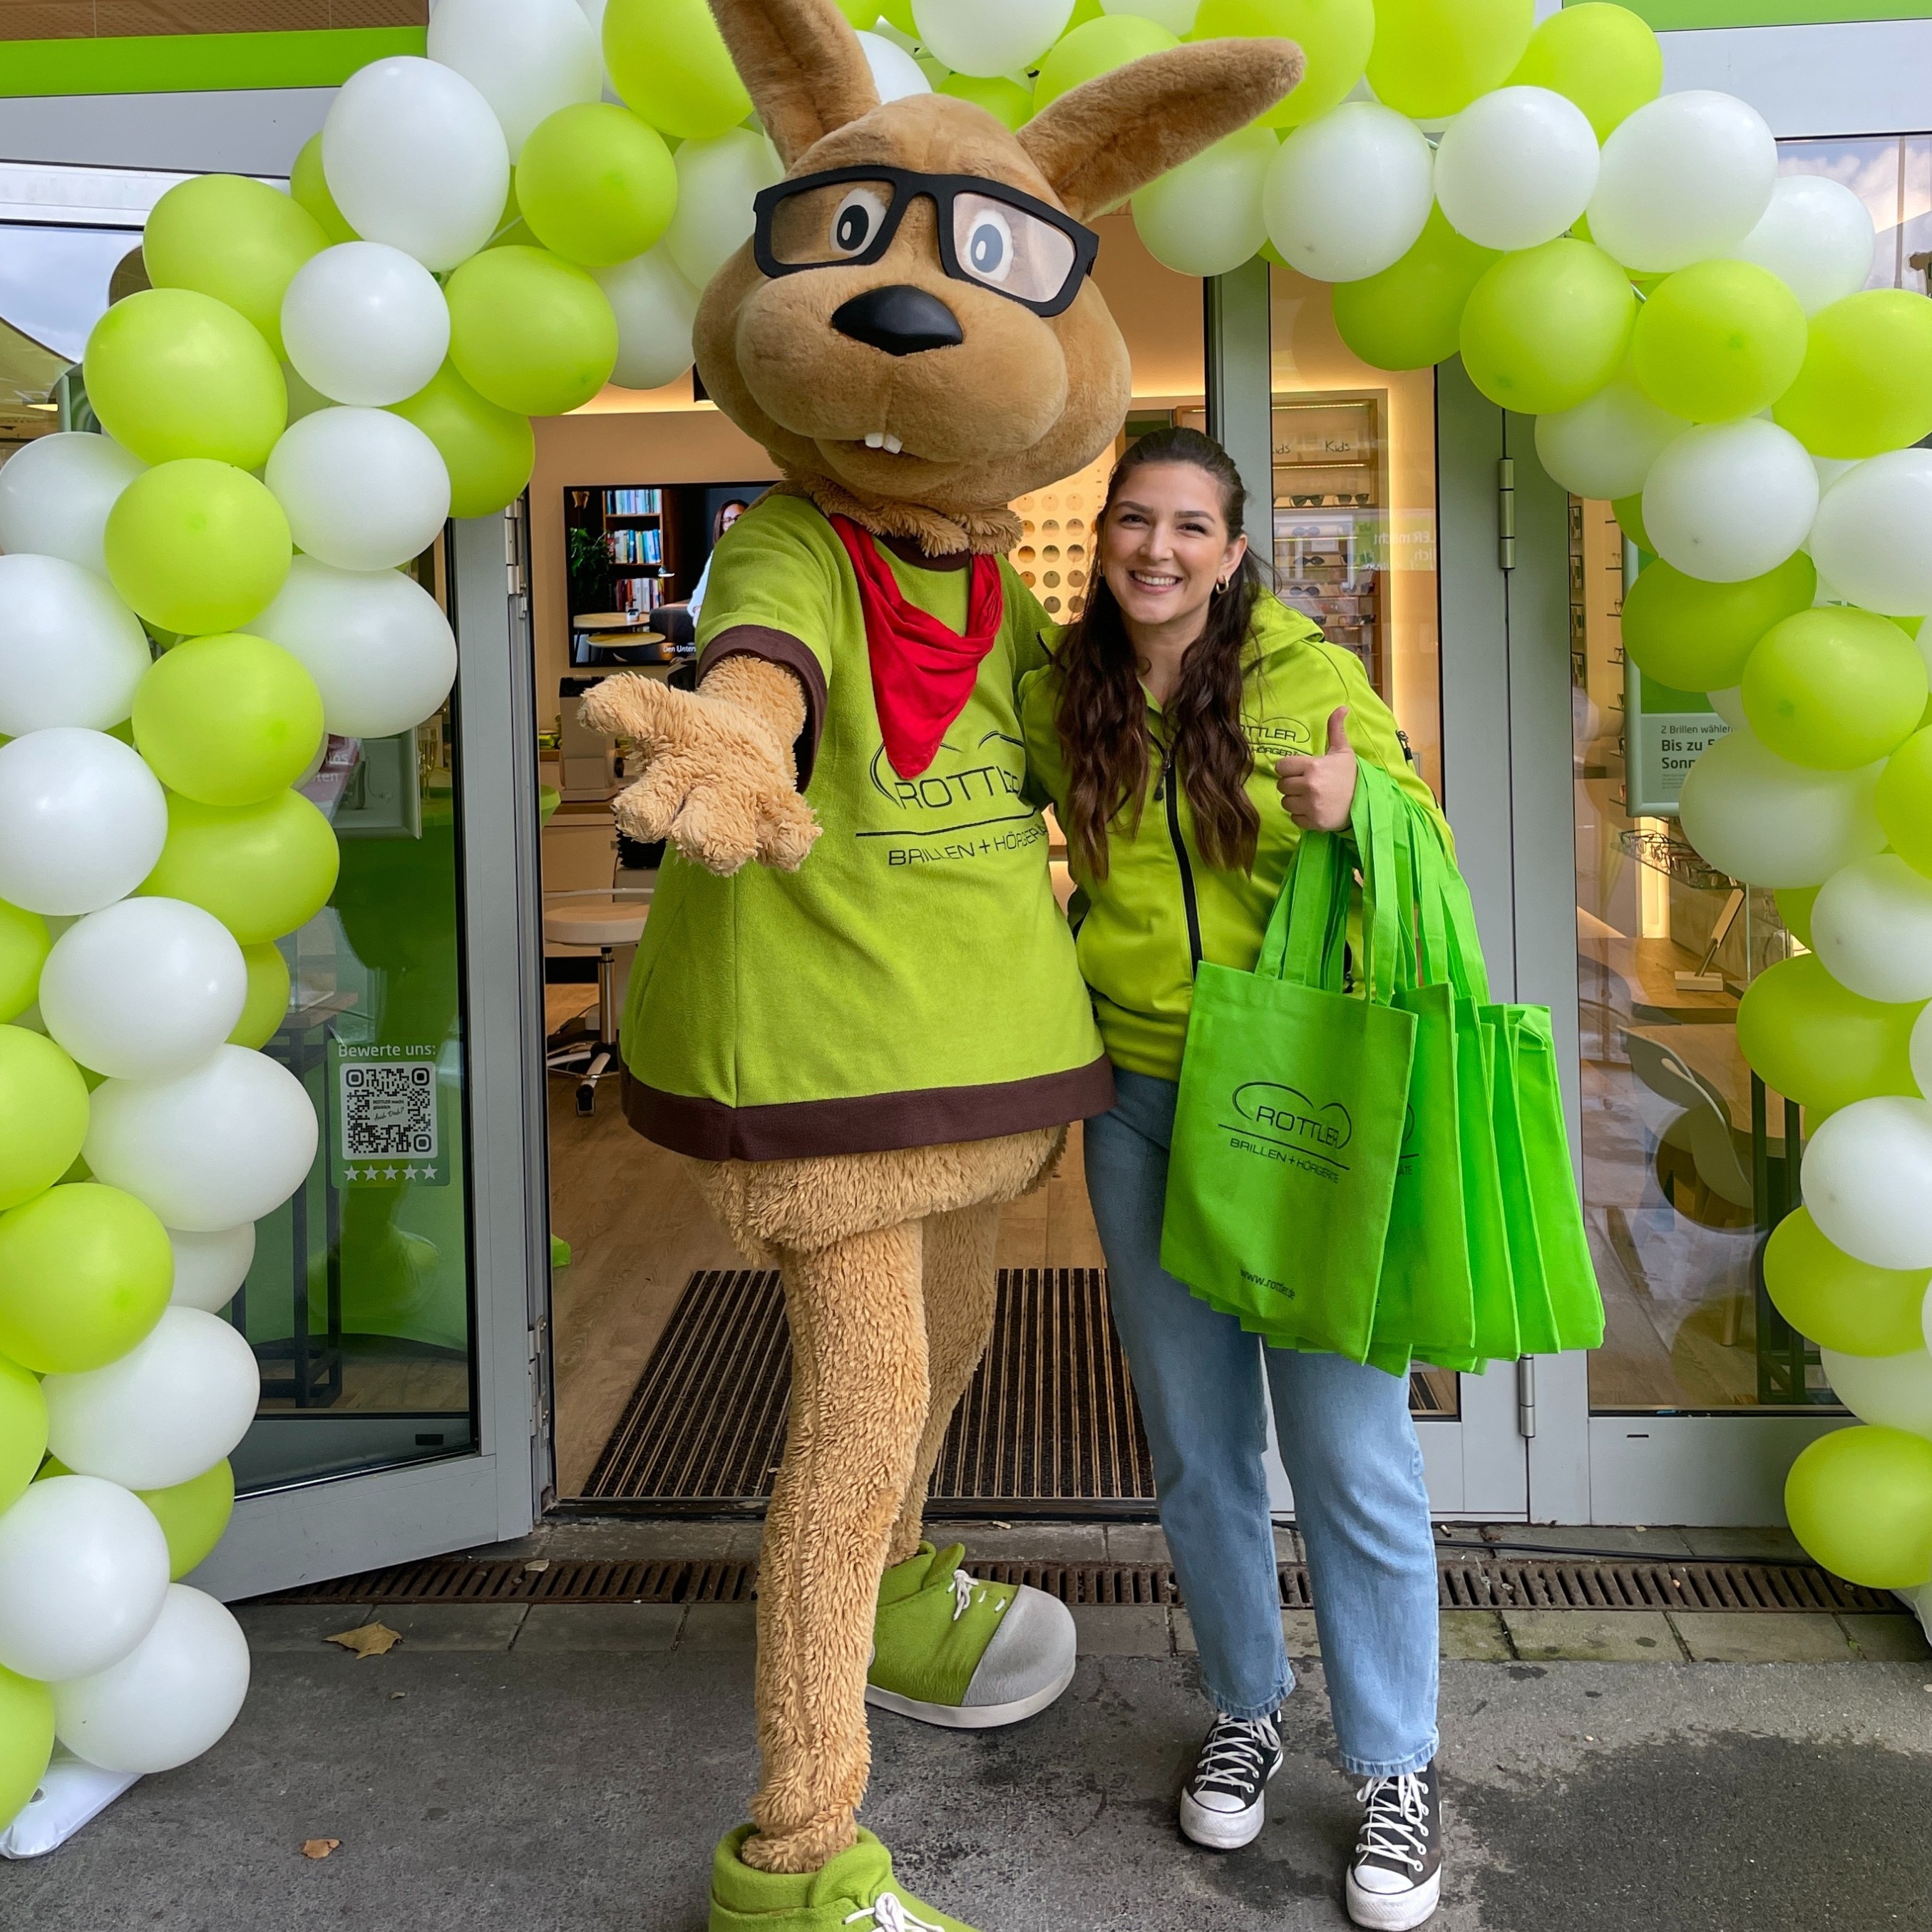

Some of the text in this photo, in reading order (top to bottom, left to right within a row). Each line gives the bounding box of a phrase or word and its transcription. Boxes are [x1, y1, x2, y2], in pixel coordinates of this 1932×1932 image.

[1325, 440, 1351, 452] Kids
[1670, 725, 1698, 734] Brillen
[1662, 739, 1682, 751] Bis
[1687, 741, 1702, 751] zu
[888, 842, 975, 865] BRILLEN
[338, 1044, 436, 1057] Bewerte uns:
[1256, 1105, 1340, 1149] ROTTLER
[1230, 1138, 1287, 1163] BRILLEN
